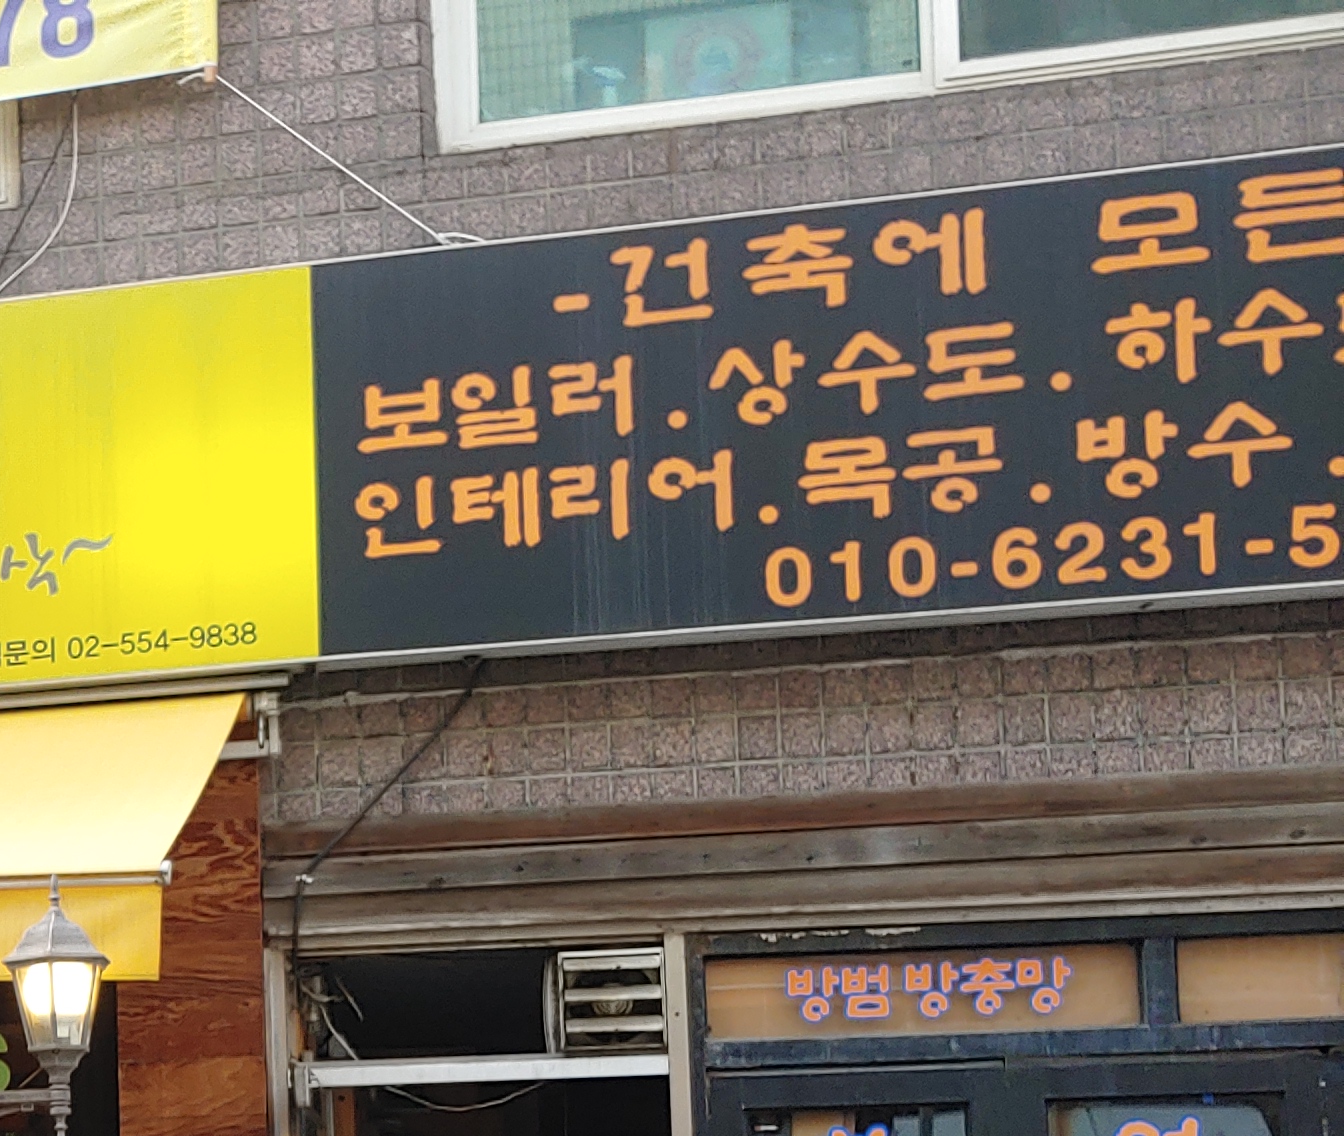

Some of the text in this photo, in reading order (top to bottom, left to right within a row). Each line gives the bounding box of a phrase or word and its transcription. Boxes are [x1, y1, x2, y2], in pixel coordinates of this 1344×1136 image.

[1090, 167, 1344, 274] 모든
[1103, 287, 1344, 385] 하수
[764, 502, 1340, 608] 010-6231-5
[66, 621, 259, 662] 02-554-9838
[786, 956, 1072, 1023] 방범 방충망
